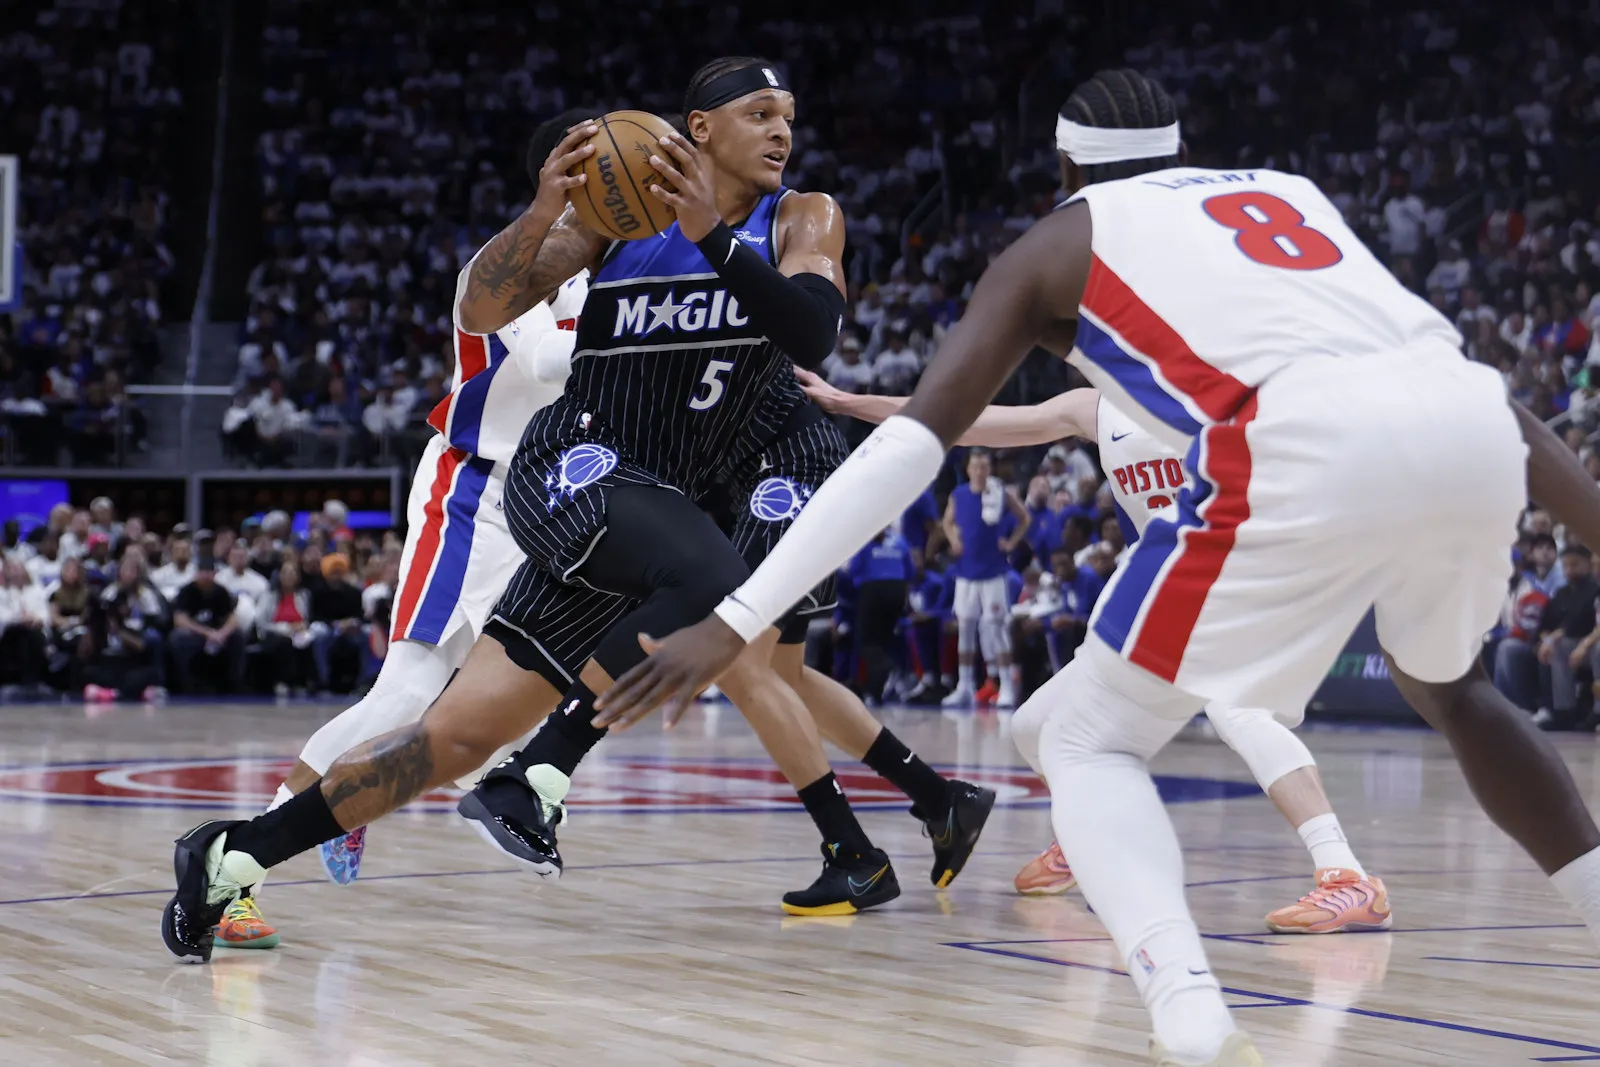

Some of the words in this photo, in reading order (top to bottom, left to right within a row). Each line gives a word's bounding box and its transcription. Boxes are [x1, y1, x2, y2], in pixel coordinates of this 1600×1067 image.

[598, 151, 640, 234] Wilson
[734, 230, 766, 246] Disney
[1202, 191, 1343, 270] 8
[688, 359, 735, 411] 5
[1112, 458, 1187, 496] PISTO
